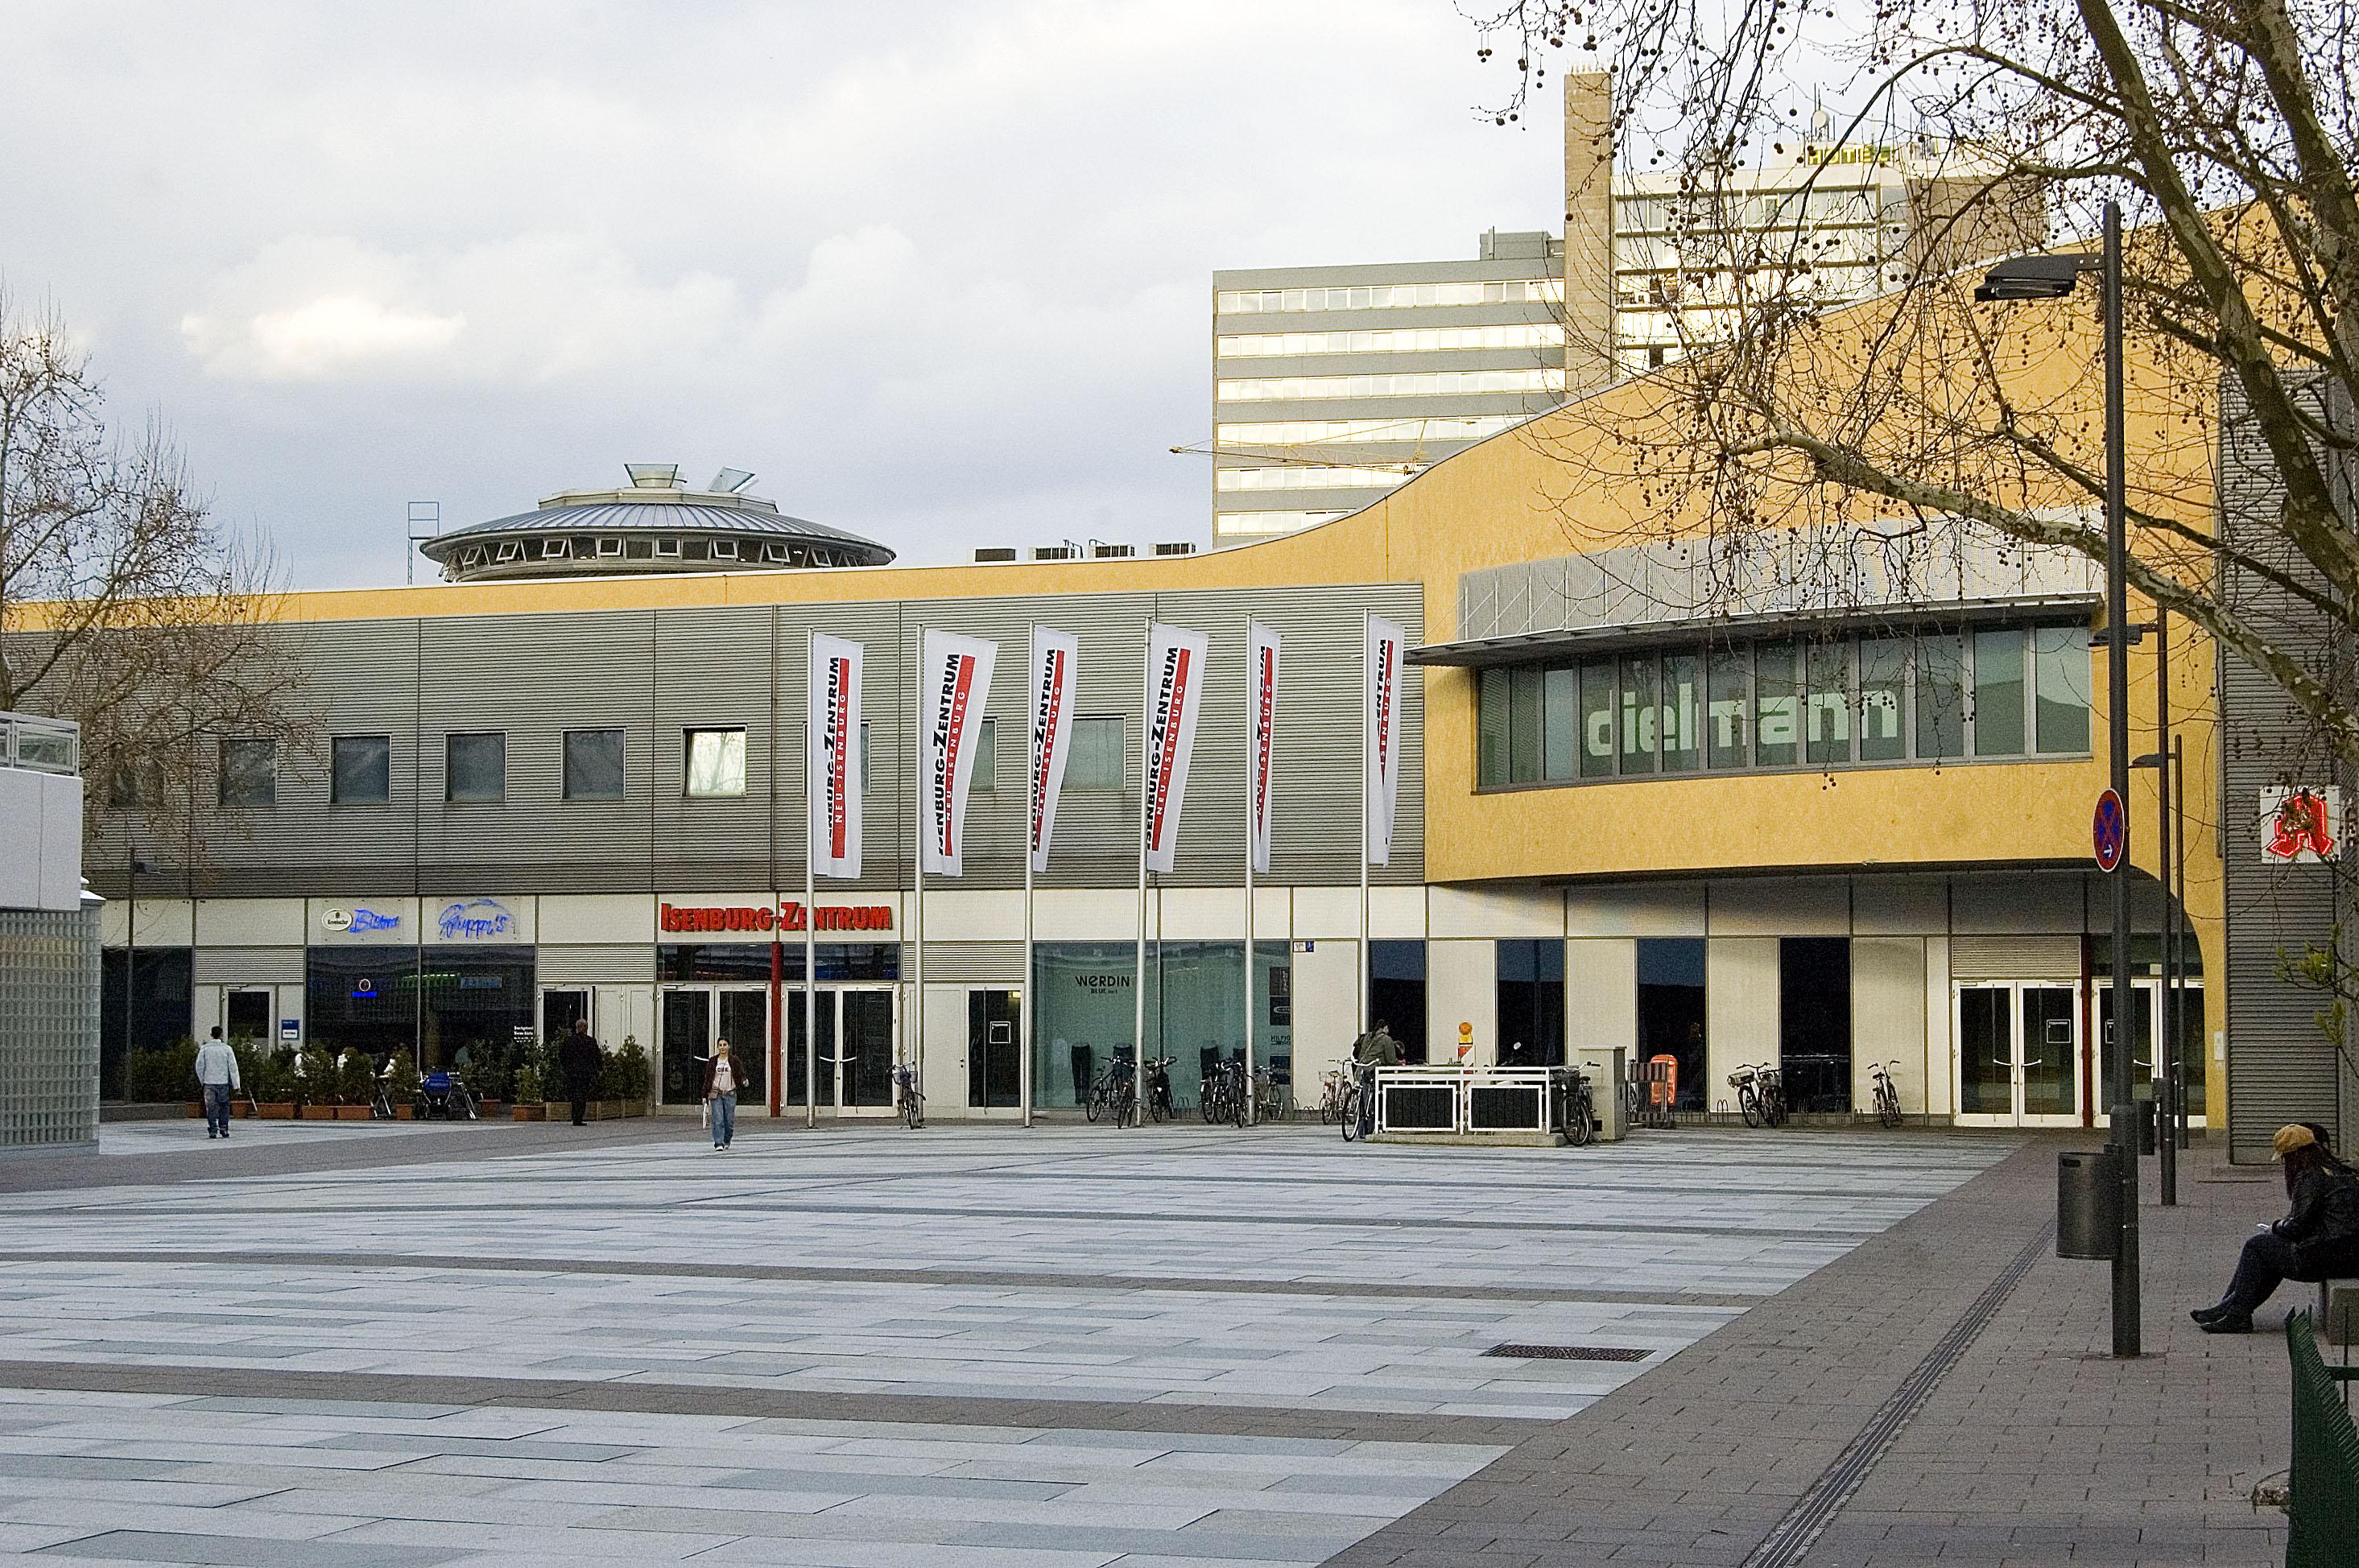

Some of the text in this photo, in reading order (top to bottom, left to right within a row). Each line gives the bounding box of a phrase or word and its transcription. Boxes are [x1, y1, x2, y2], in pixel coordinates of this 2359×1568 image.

[835, 694, 846, 823] NEU-ISENBURG
[946, 691, 966, 821] NEU-ISENBURG
[1039, 687, 1060, 816] NEU-ISENBURG
[1156, 684, 1183, 815] NEU-ISENBURG
